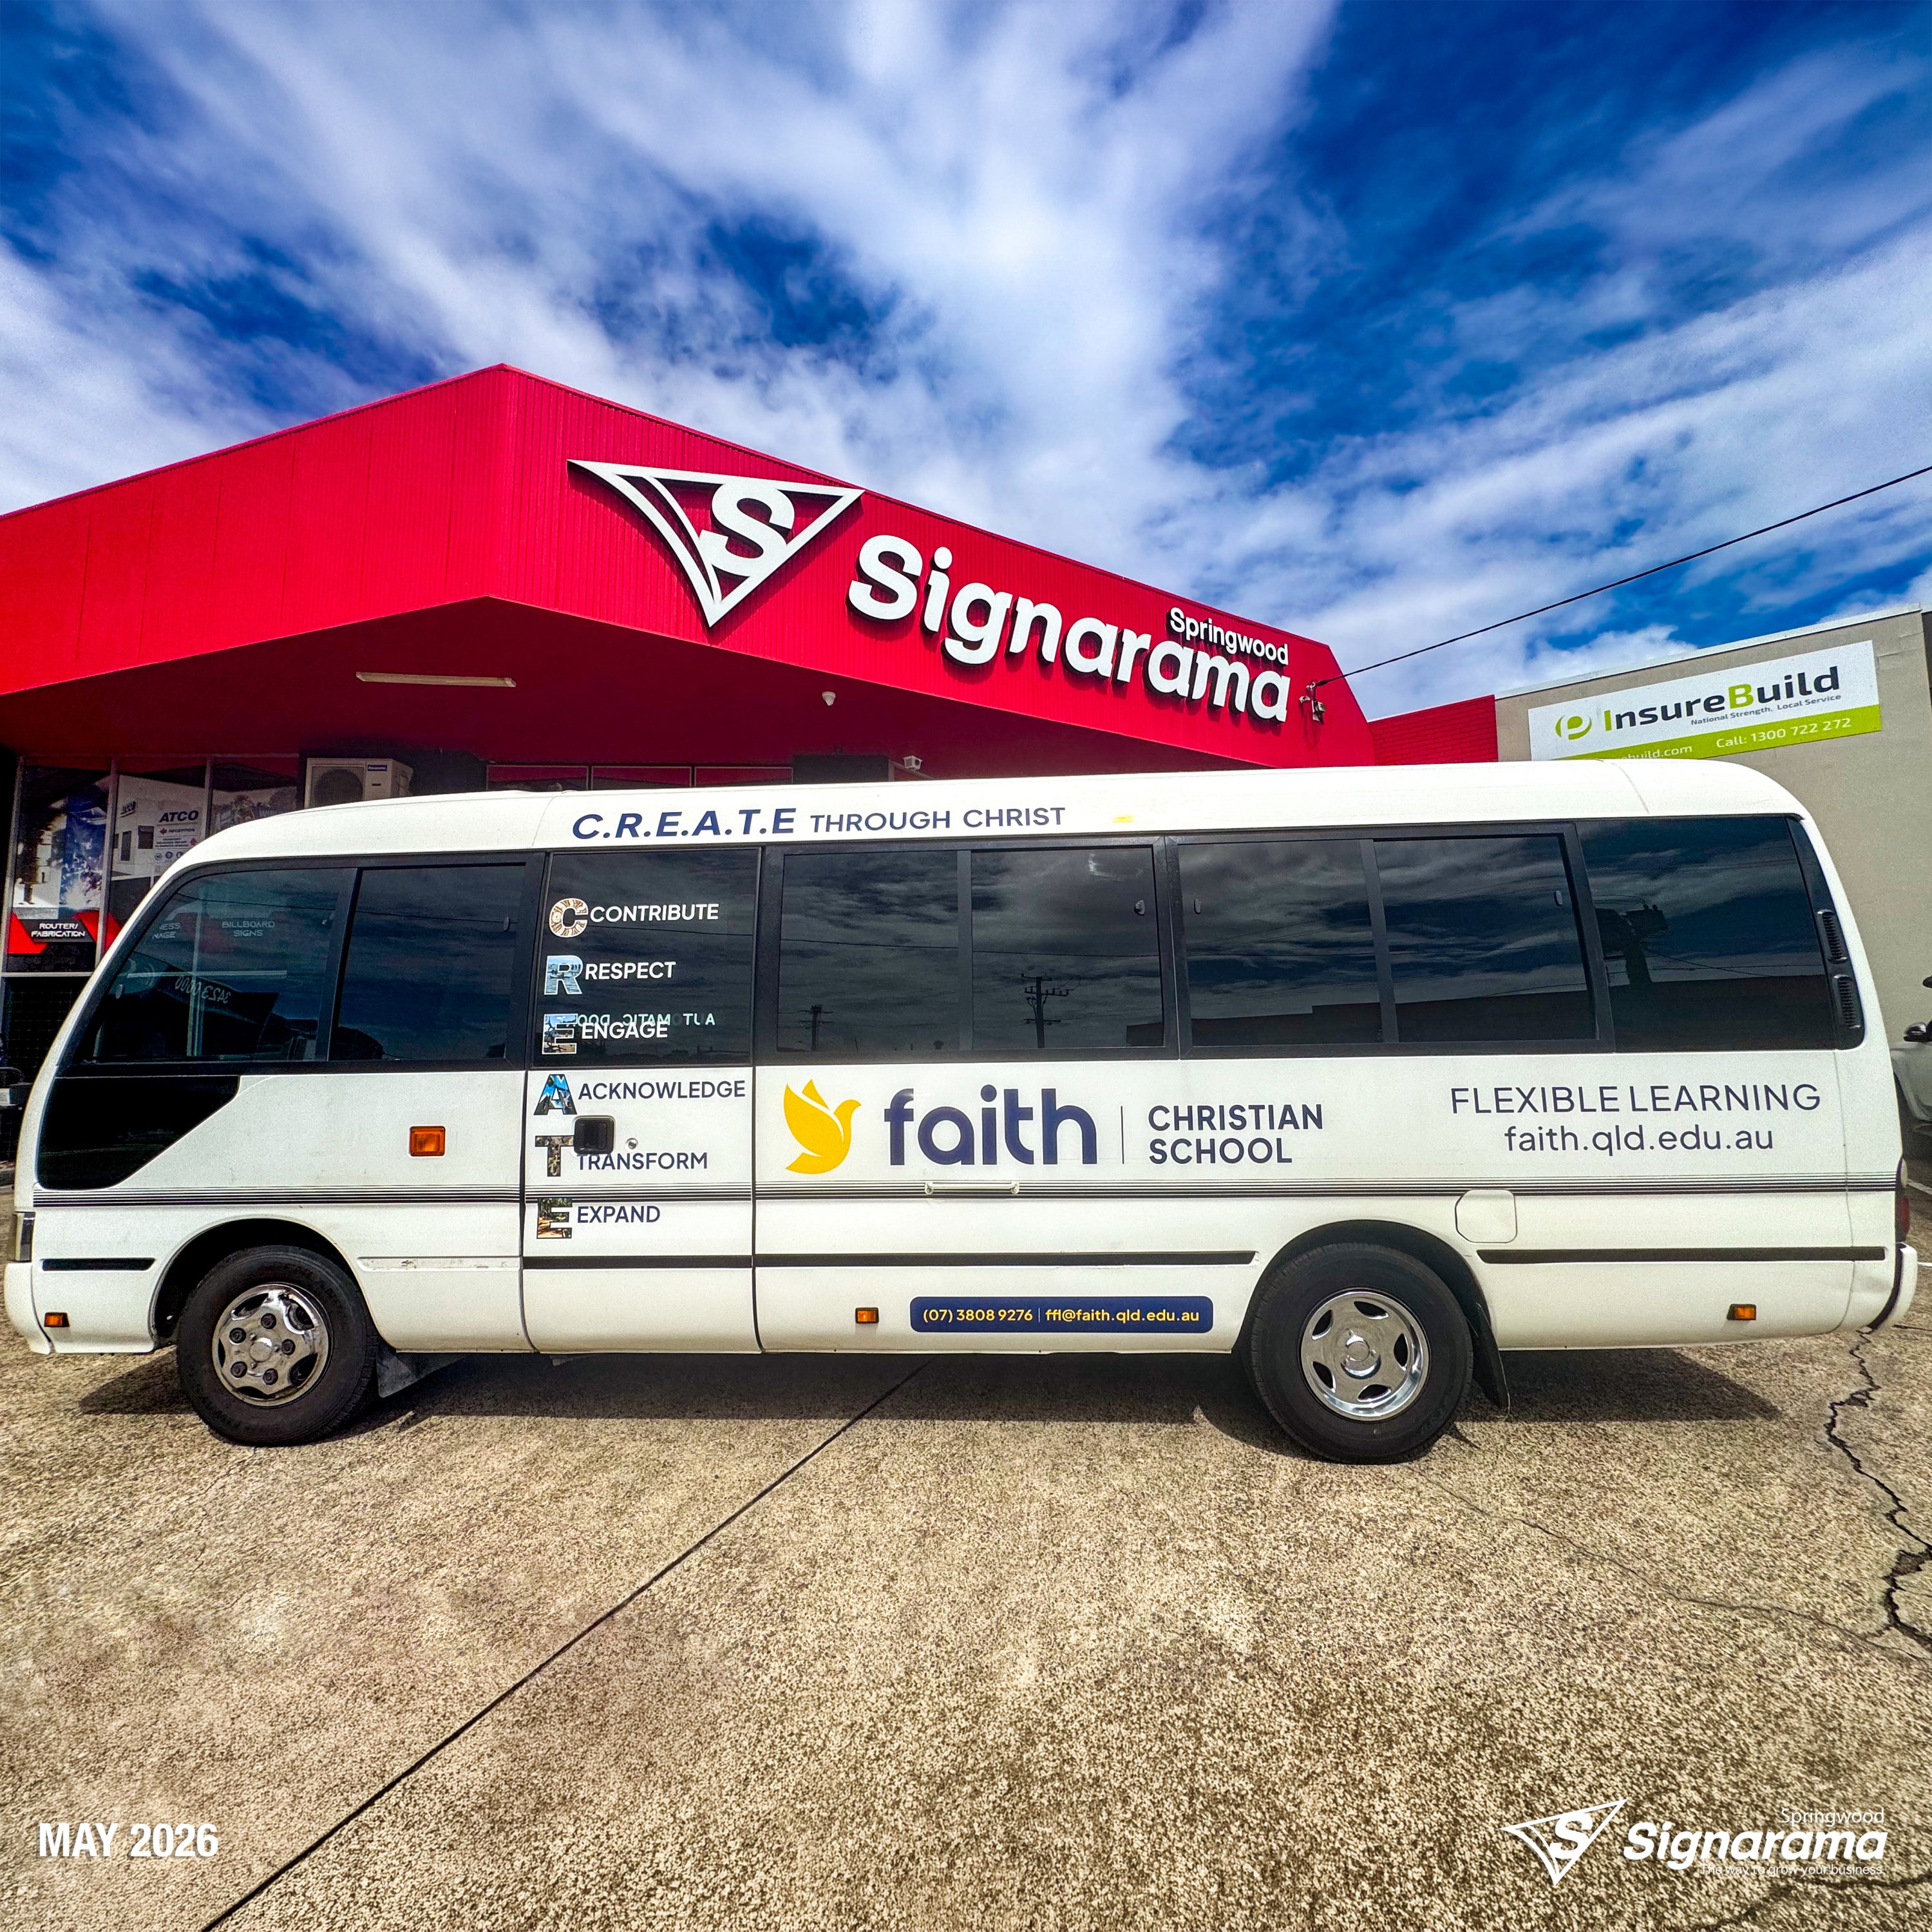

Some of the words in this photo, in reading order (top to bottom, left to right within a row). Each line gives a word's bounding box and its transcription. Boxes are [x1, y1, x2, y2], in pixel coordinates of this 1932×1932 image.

[699, 480, 795, 578] S
[848, 535, 1291, 723] Signarama
[1168, 607, 1289, 666] Springwood
[1604, 666, 1840, 732] InsureBuild
[1691, 714, 1728, 725] National
[1777, 701, 1803, 710] Local
[1804, 694, 1842, 705] Service
[1716, 736, 1747, 748] Call:
[1751, 728, 1786, 743] 1300
[1790, 723, 1819, 736] 722
[1823, 718, 1852, 730] 272
[158, 810, 199, 822] ATCO
[573, 808, 797, 839] C.R.E.A.T.E
[810, 810, 951, 833] THROUGH
[963, 807, 1066, 830] CHRIST
[590, 903, 719, 923] CONTRIBUTE
[585, 961, 676, 980] RESPECT
[582, 1021, 668, 1039] ENGAGE
[578, 1080, 746, 1100] ACKNOWLEDGE
[1451, 1086, 1620, 1114] FLEXIBLE
[1630, 1084, 1820, 1112] LEARNING
[884, 1084, 1097, 1166] faith
[1148, 1104, 1323, 1132] CHRISTIAN
[1149, 1137, 1293, 1164] SCHOOL
[1504, 1124, 1773, 1157] faith.qld.edu.au
[577, 1152, 708, 1170] TRANSFORM
[577, 1206, 660, 1223] EXPAND
[923, 1309, 953, 1323] (07)
[956, 1309, 995, 1321] 3808
[998, 1309, 1033, 1321] 9276
[1045, 1309, 1199, 1324] ffl@faith.qld.edu.au
